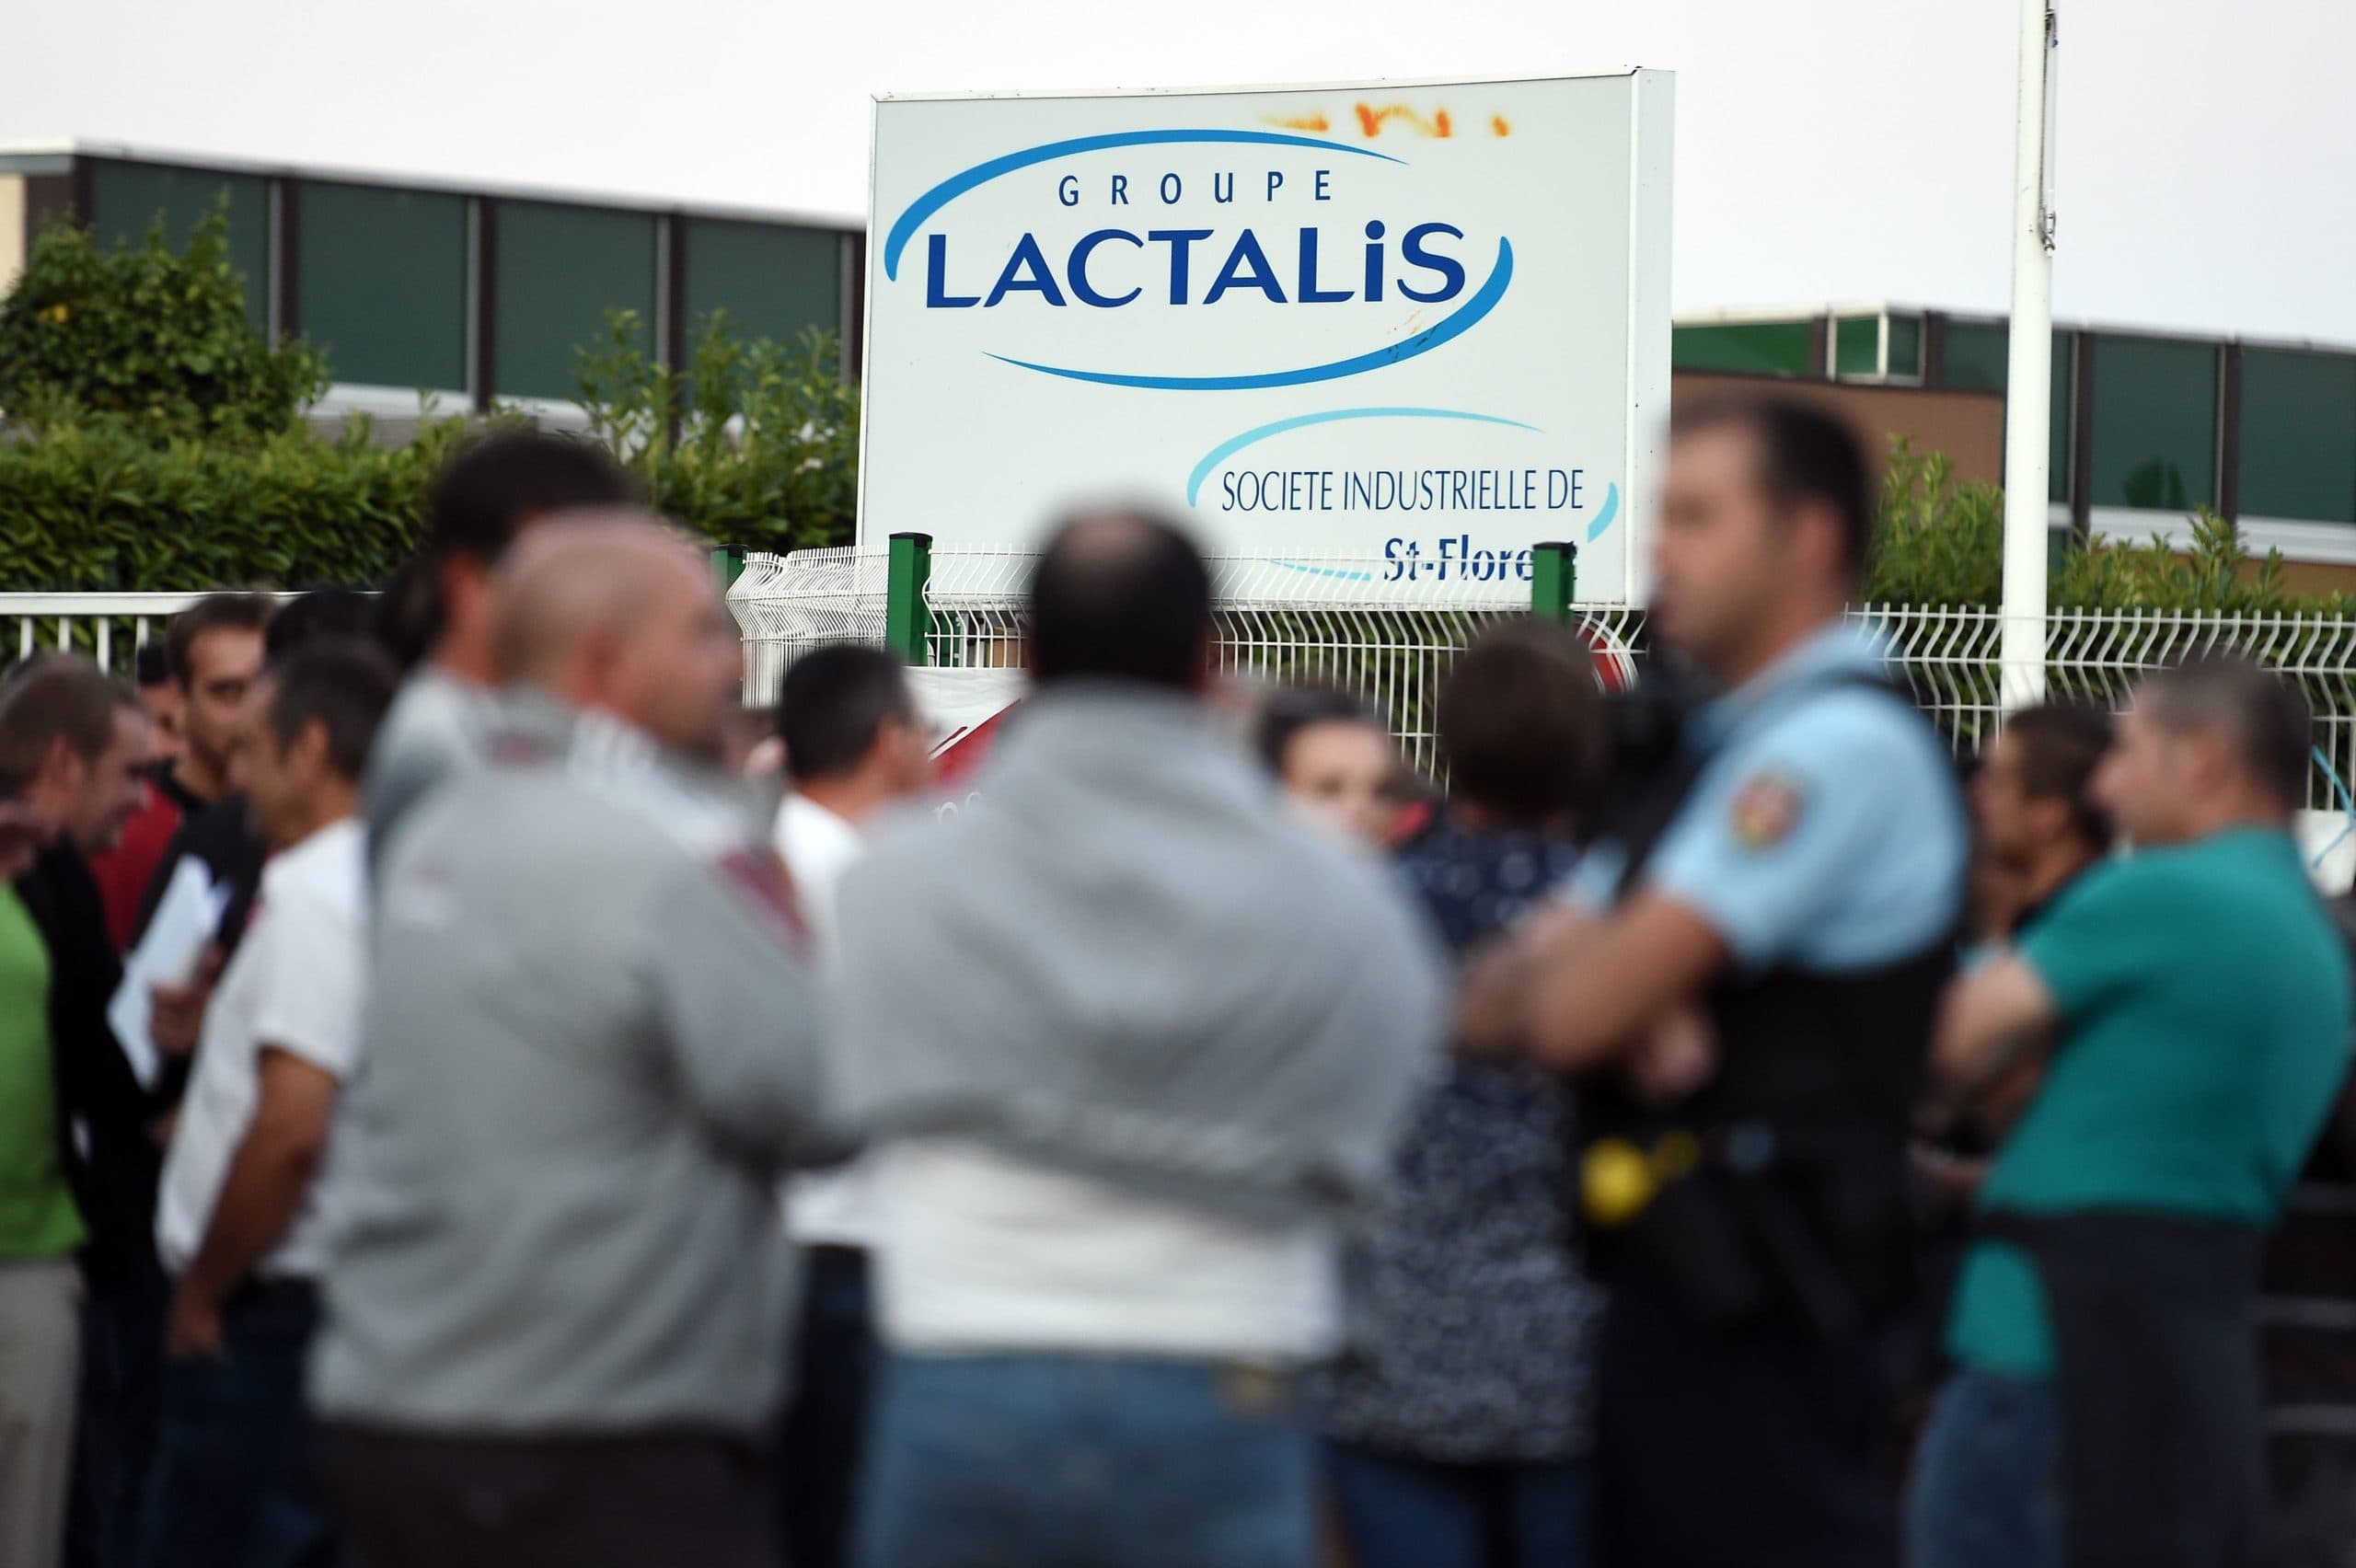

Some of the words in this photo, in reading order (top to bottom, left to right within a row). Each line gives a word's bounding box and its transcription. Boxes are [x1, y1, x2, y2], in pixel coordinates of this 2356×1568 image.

[1058, 169, 1332, 207] GROUPE
[1221, 470, 1334, 512] SOCIETE
[1344, 469, 1537, 511] INDUSTRIELLE
[1548, 469, 1584, 510] DE
[1383, 534, 1578, 582] St-Flore
